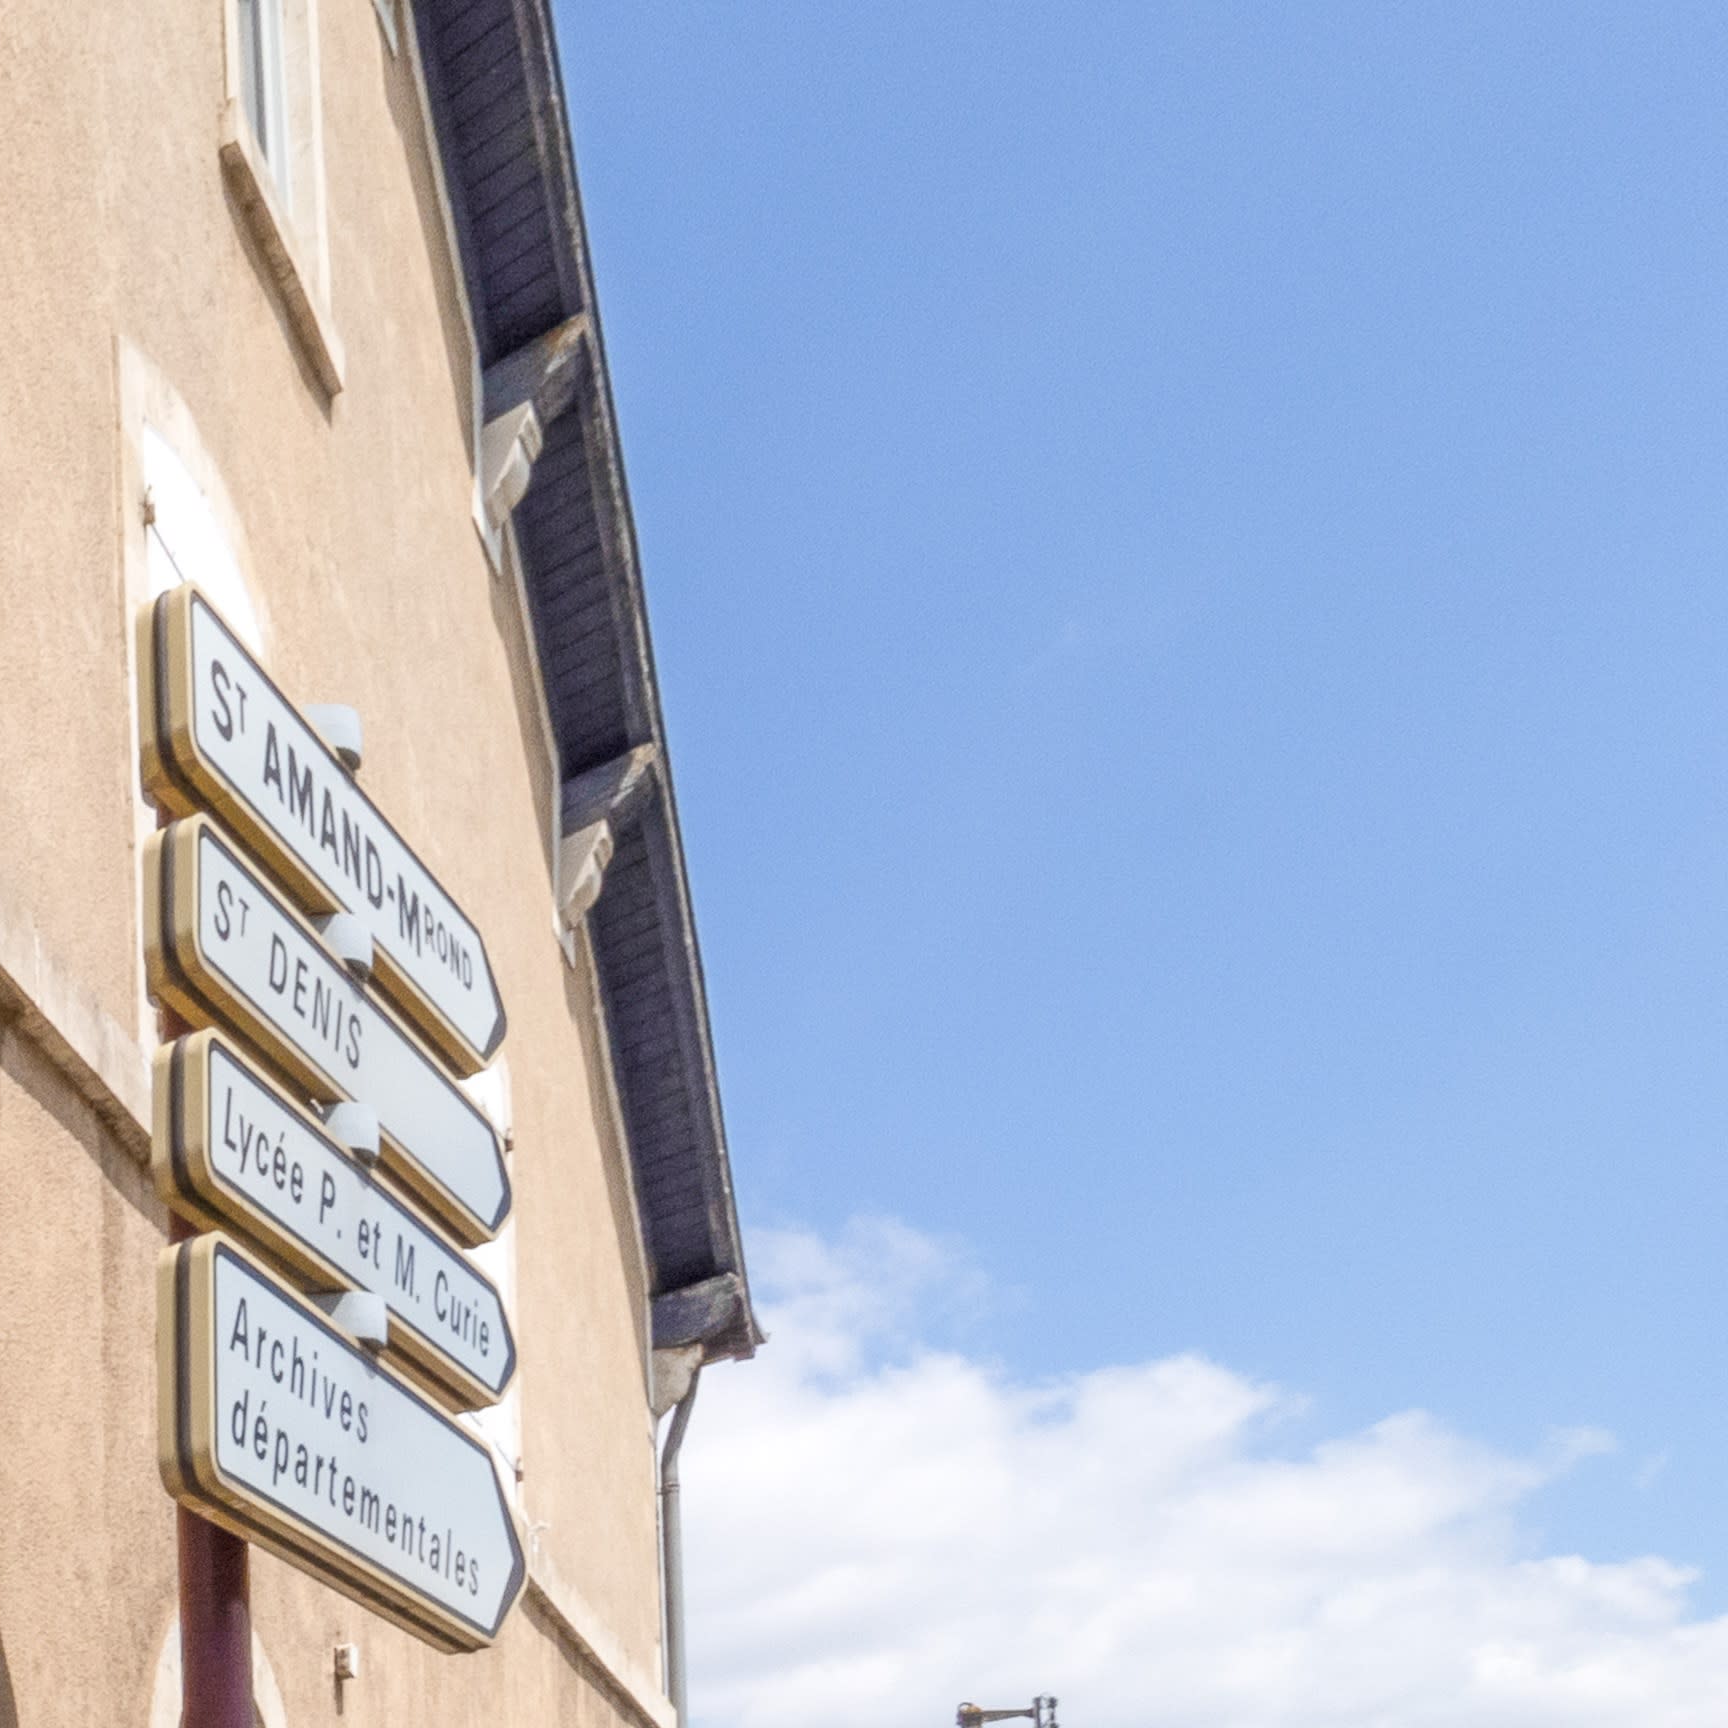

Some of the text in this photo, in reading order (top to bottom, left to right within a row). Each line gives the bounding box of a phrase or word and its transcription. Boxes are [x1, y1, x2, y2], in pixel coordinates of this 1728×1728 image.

[269, 933, 362, 1069] DENIS
[224, 1088, 489, 1357] Lycée P. et M. Curie
[230, 1298, 369, 1444] Archives
[232, 1389, 479, 1595] départementales
